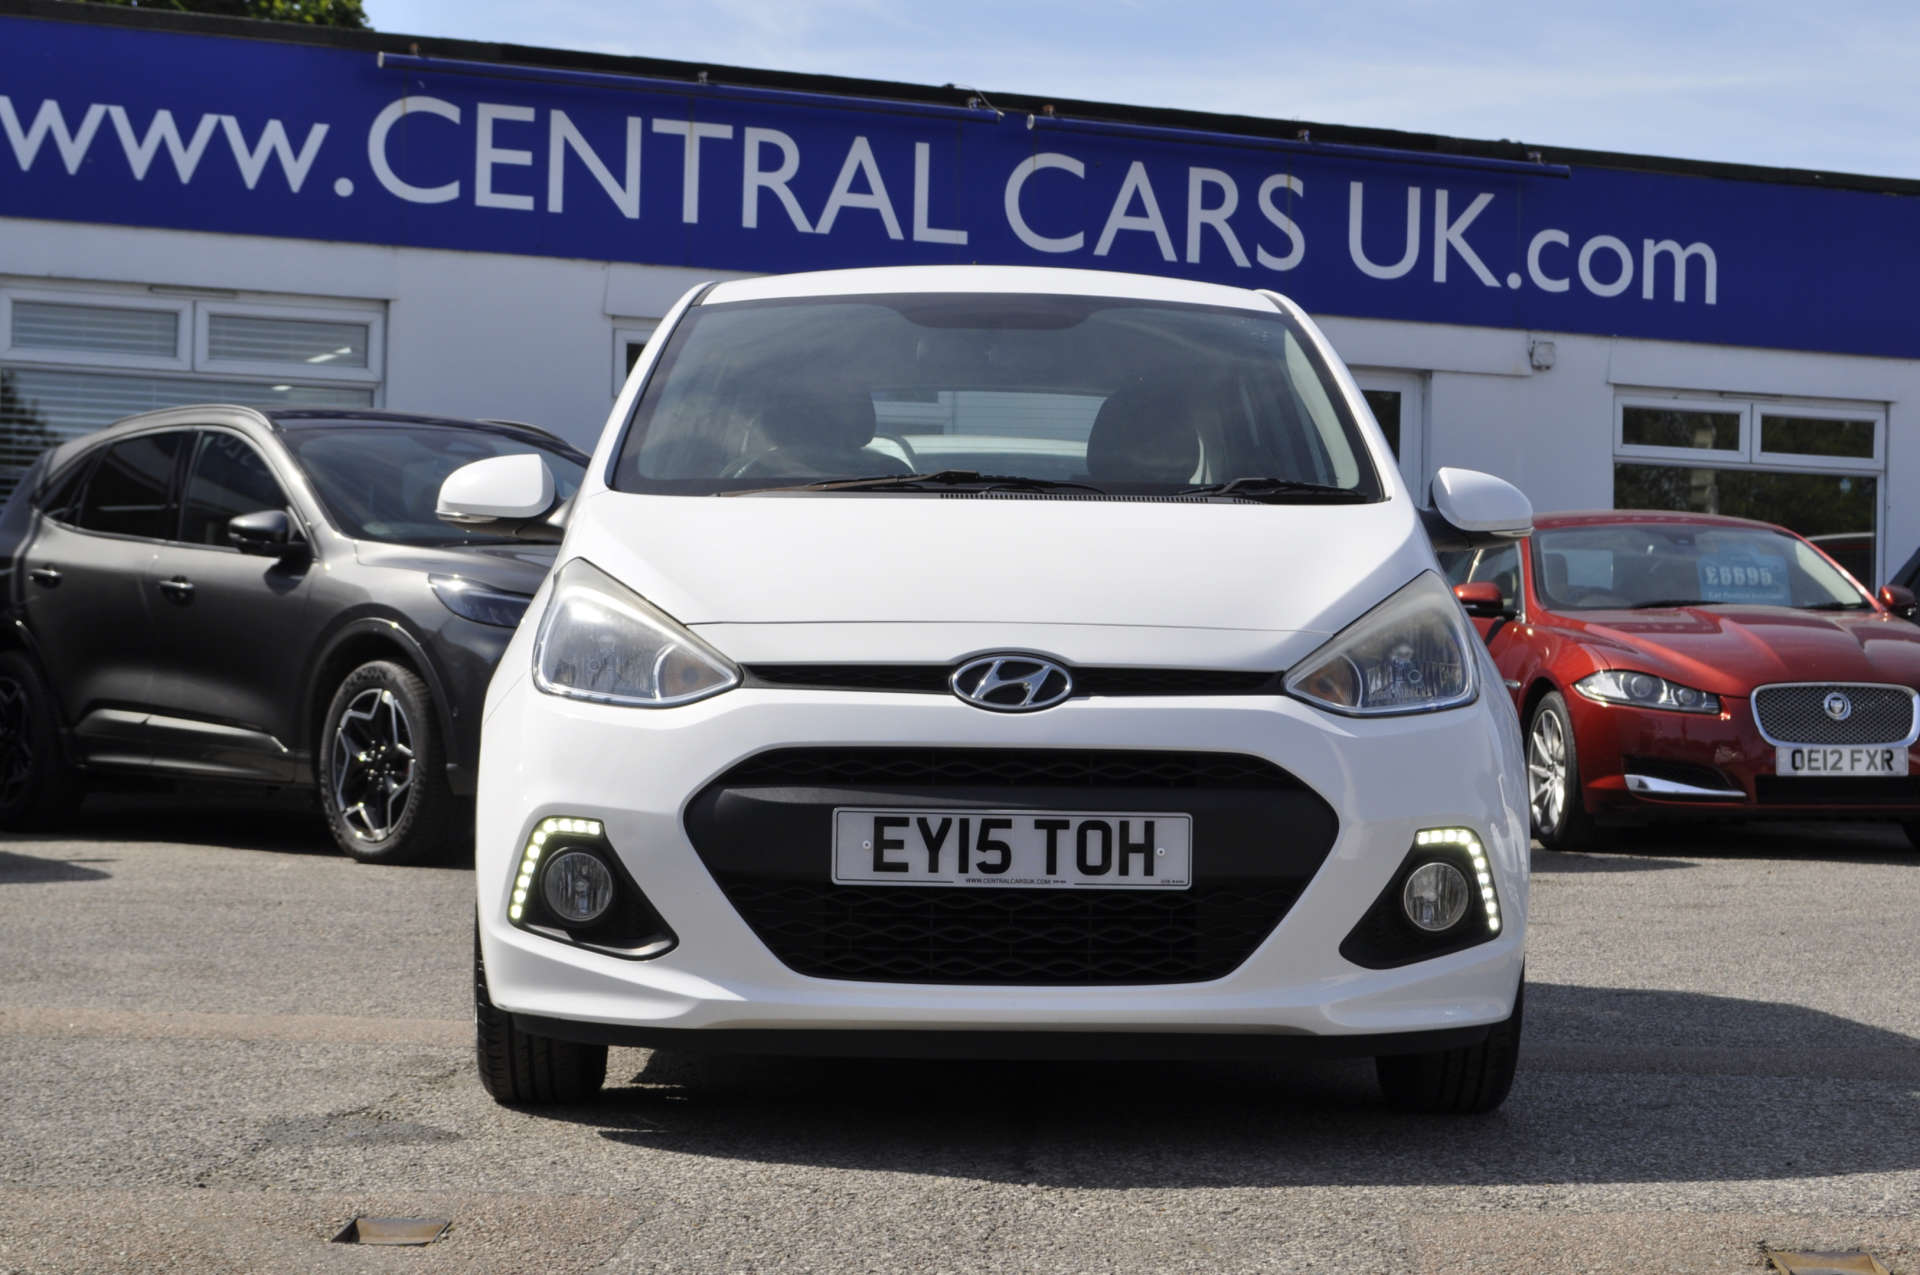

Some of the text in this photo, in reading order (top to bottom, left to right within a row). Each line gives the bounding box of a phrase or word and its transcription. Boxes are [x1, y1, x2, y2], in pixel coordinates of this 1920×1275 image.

[0, 94, 1718, 304] www.CENTRAL CARS UK.com
[1791, 750, 1894, 771] OE12 FXR
[872, 816, 1156, 877] EY15 TOH
